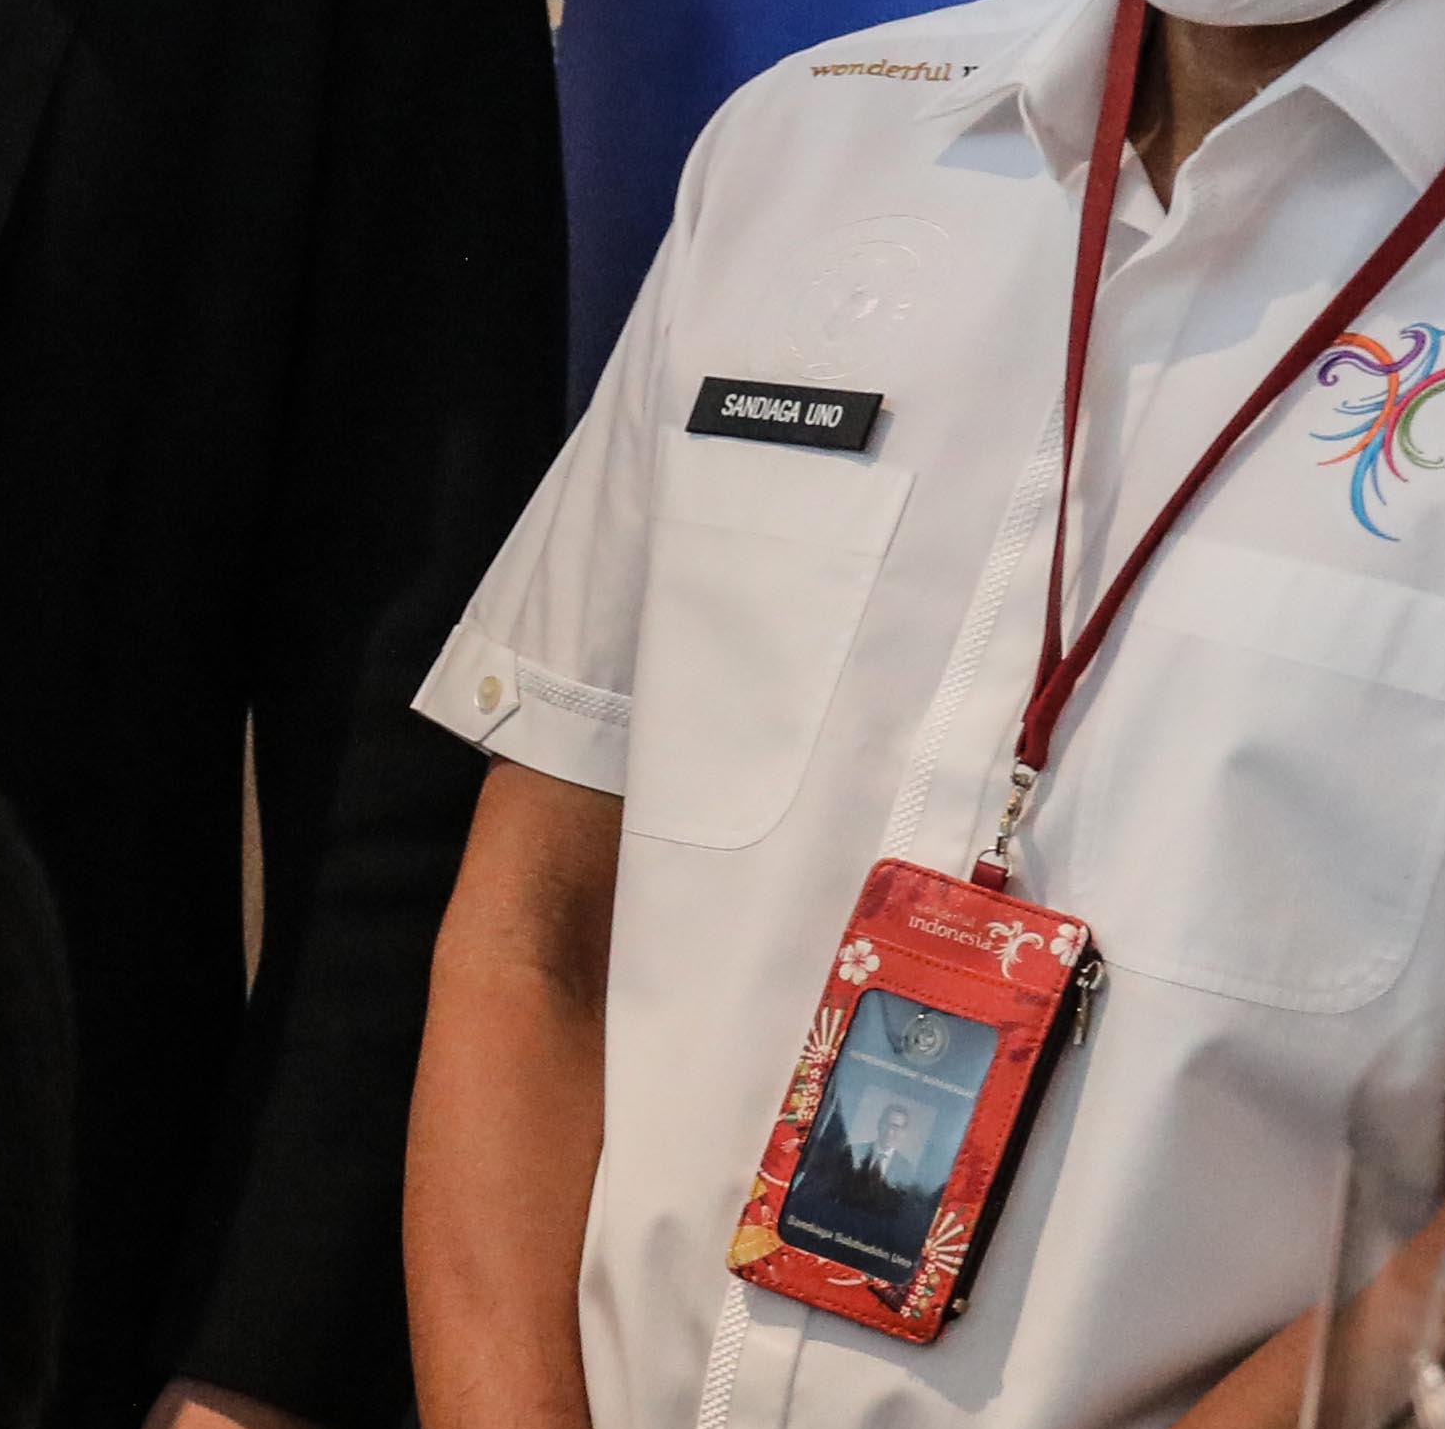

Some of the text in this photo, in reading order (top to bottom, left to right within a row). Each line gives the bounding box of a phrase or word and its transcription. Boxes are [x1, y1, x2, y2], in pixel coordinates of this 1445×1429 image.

[810, 59, 953, 82] wonderful
[720, 393, 844, 428] SANDIAGA UNO
